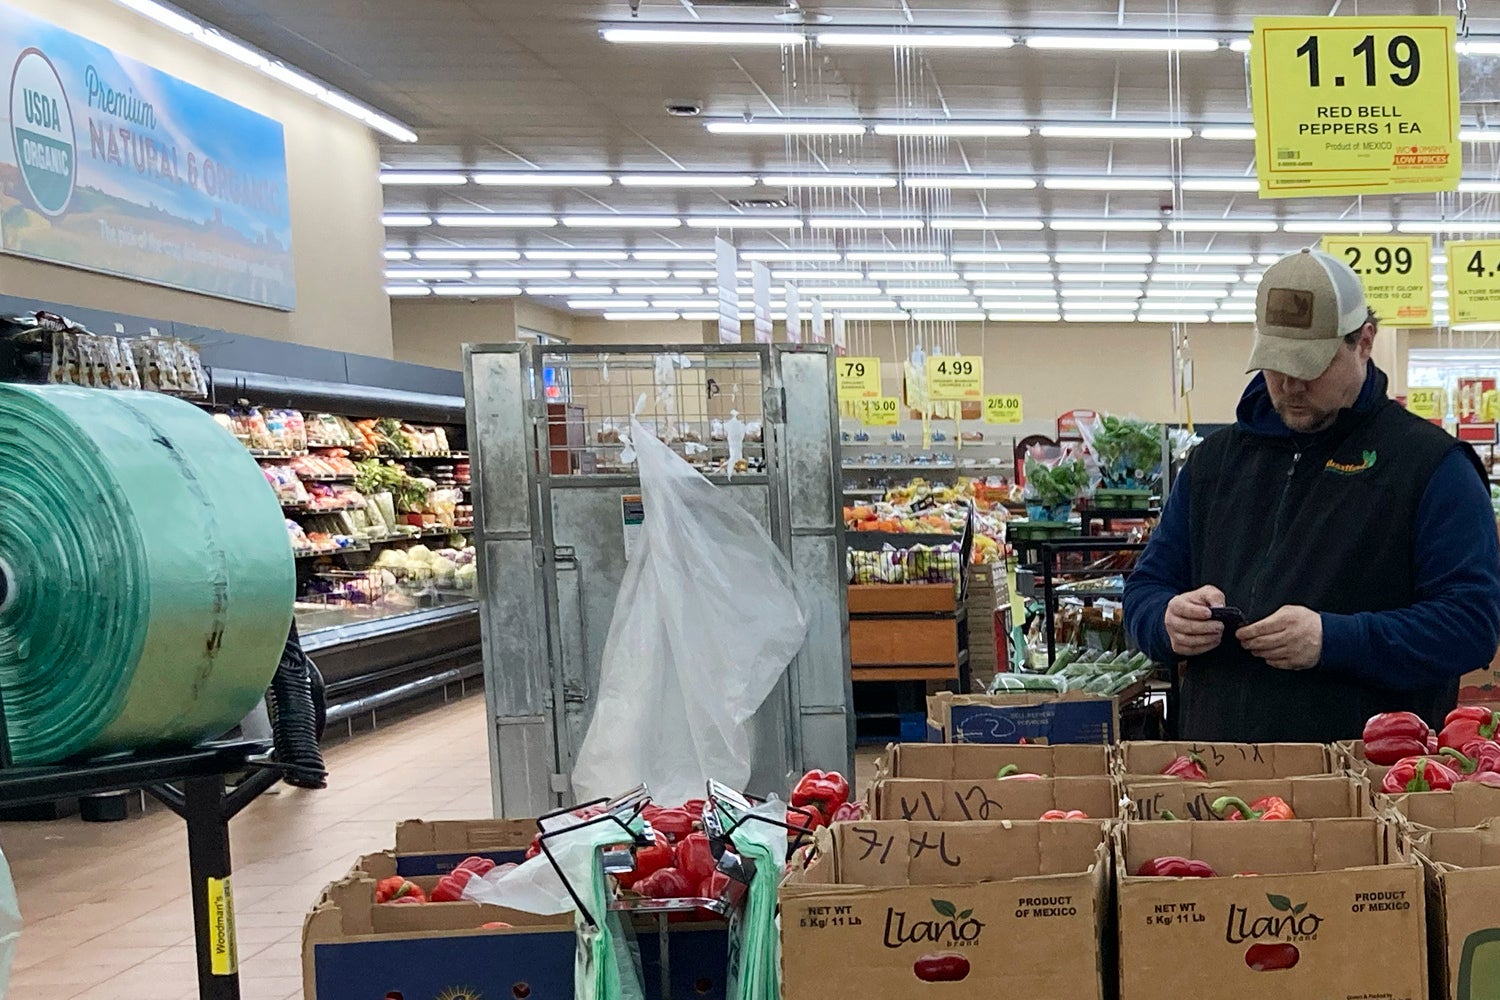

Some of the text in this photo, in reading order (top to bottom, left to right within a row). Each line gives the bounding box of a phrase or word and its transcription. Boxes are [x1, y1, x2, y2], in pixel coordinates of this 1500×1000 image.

[1297, 35, 1421, 87] 1.19
[85, 65, 156, 131] Premium
[23, 88, 61, 132] USDA
[1317, 106, 1402, 118] RED BELL
[1299, 122, 1421, 135] PEPPERS 1 EA
[88, 117, 183, 184] NATURAL
[1325, 142, 1349, 151] Product
[1362, 142, 1392, 150] MEXICO
[23, 138, 69, 177] ORGANIC
[1395, 154, 1448, 165] LOW PRICES
[1344, 247, 1412, 274] 2.99
[938, 361, 972, 375] 4.99
[988, 398, 1019, 409] 2/5.00
[1019, 896, 1072, 907] PRODUCT
[1356, 891, 1406, 902] PRODUCT
[808, 906, 852, 915] NET WT
[1155, 903, 1196, 913] NET WT
[1352, 901, 1410, 912] OF MEXICO
[1016, 907, 1077, 918] OF MEXICO
[214, 896, 226, 954] Woodman's
[946, 939, 979, 947] brand
[1287, 934, 1317, 942] brand
